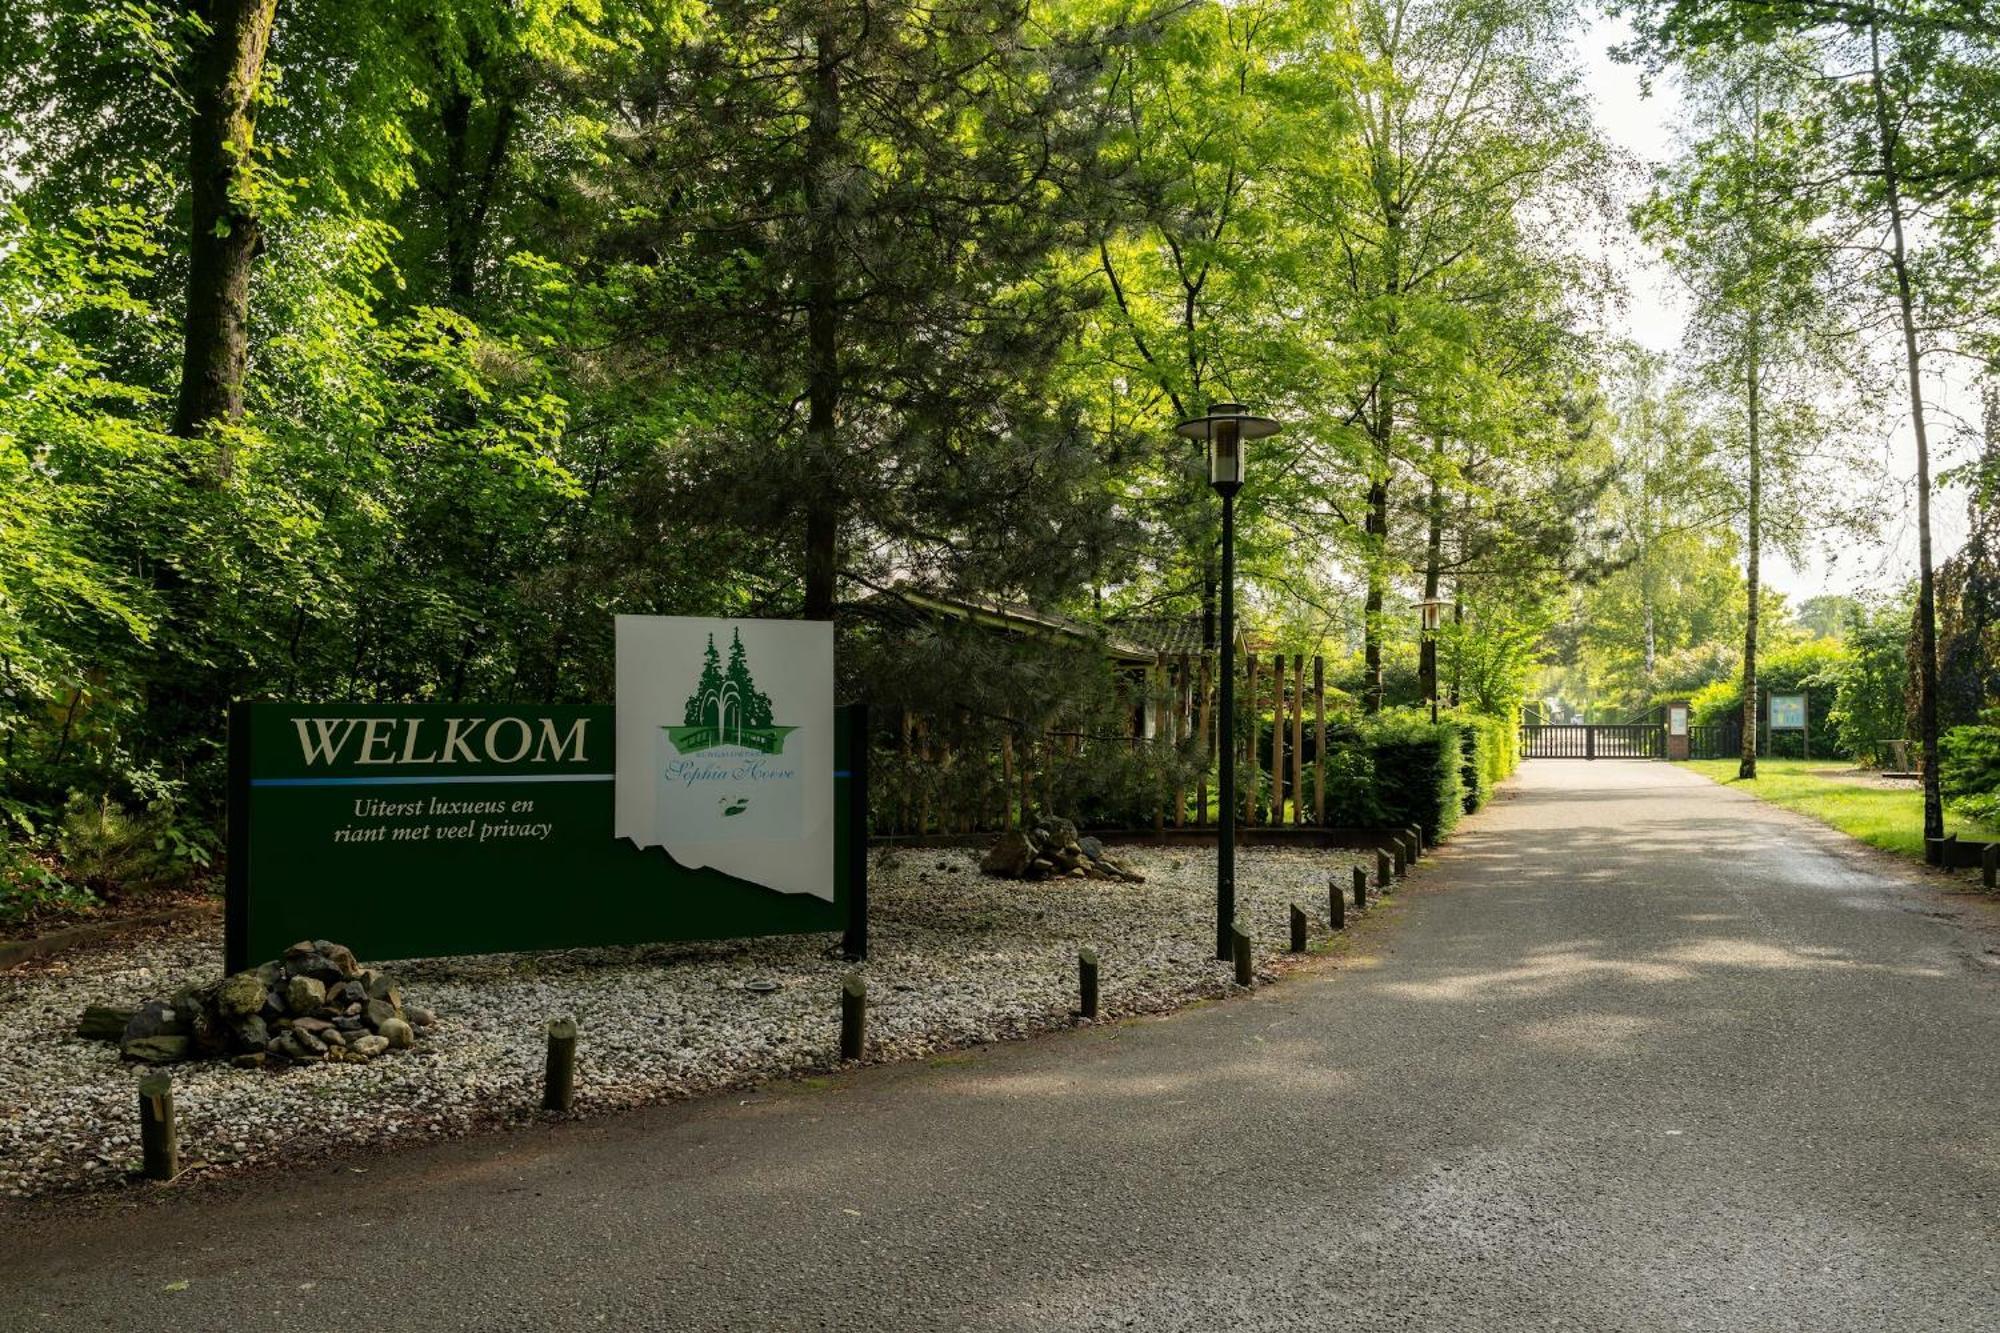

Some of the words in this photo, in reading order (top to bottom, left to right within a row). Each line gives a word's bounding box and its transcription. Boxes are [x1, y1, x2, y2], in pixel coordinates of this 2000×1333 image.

[290, 717, 591, 766] WELKOM
[664, 759, 728, 787] Sophia
[353, 799, 425, 818] Uiterst
[429, 796, 507, 816] luxueus
[511, 800, 535, 814] en
[334, 824, 388, 844] riant
[392, 824, 431, 842] met
[436, 819, 477, 840] veel
[479, 822, 553, 844] privacy
